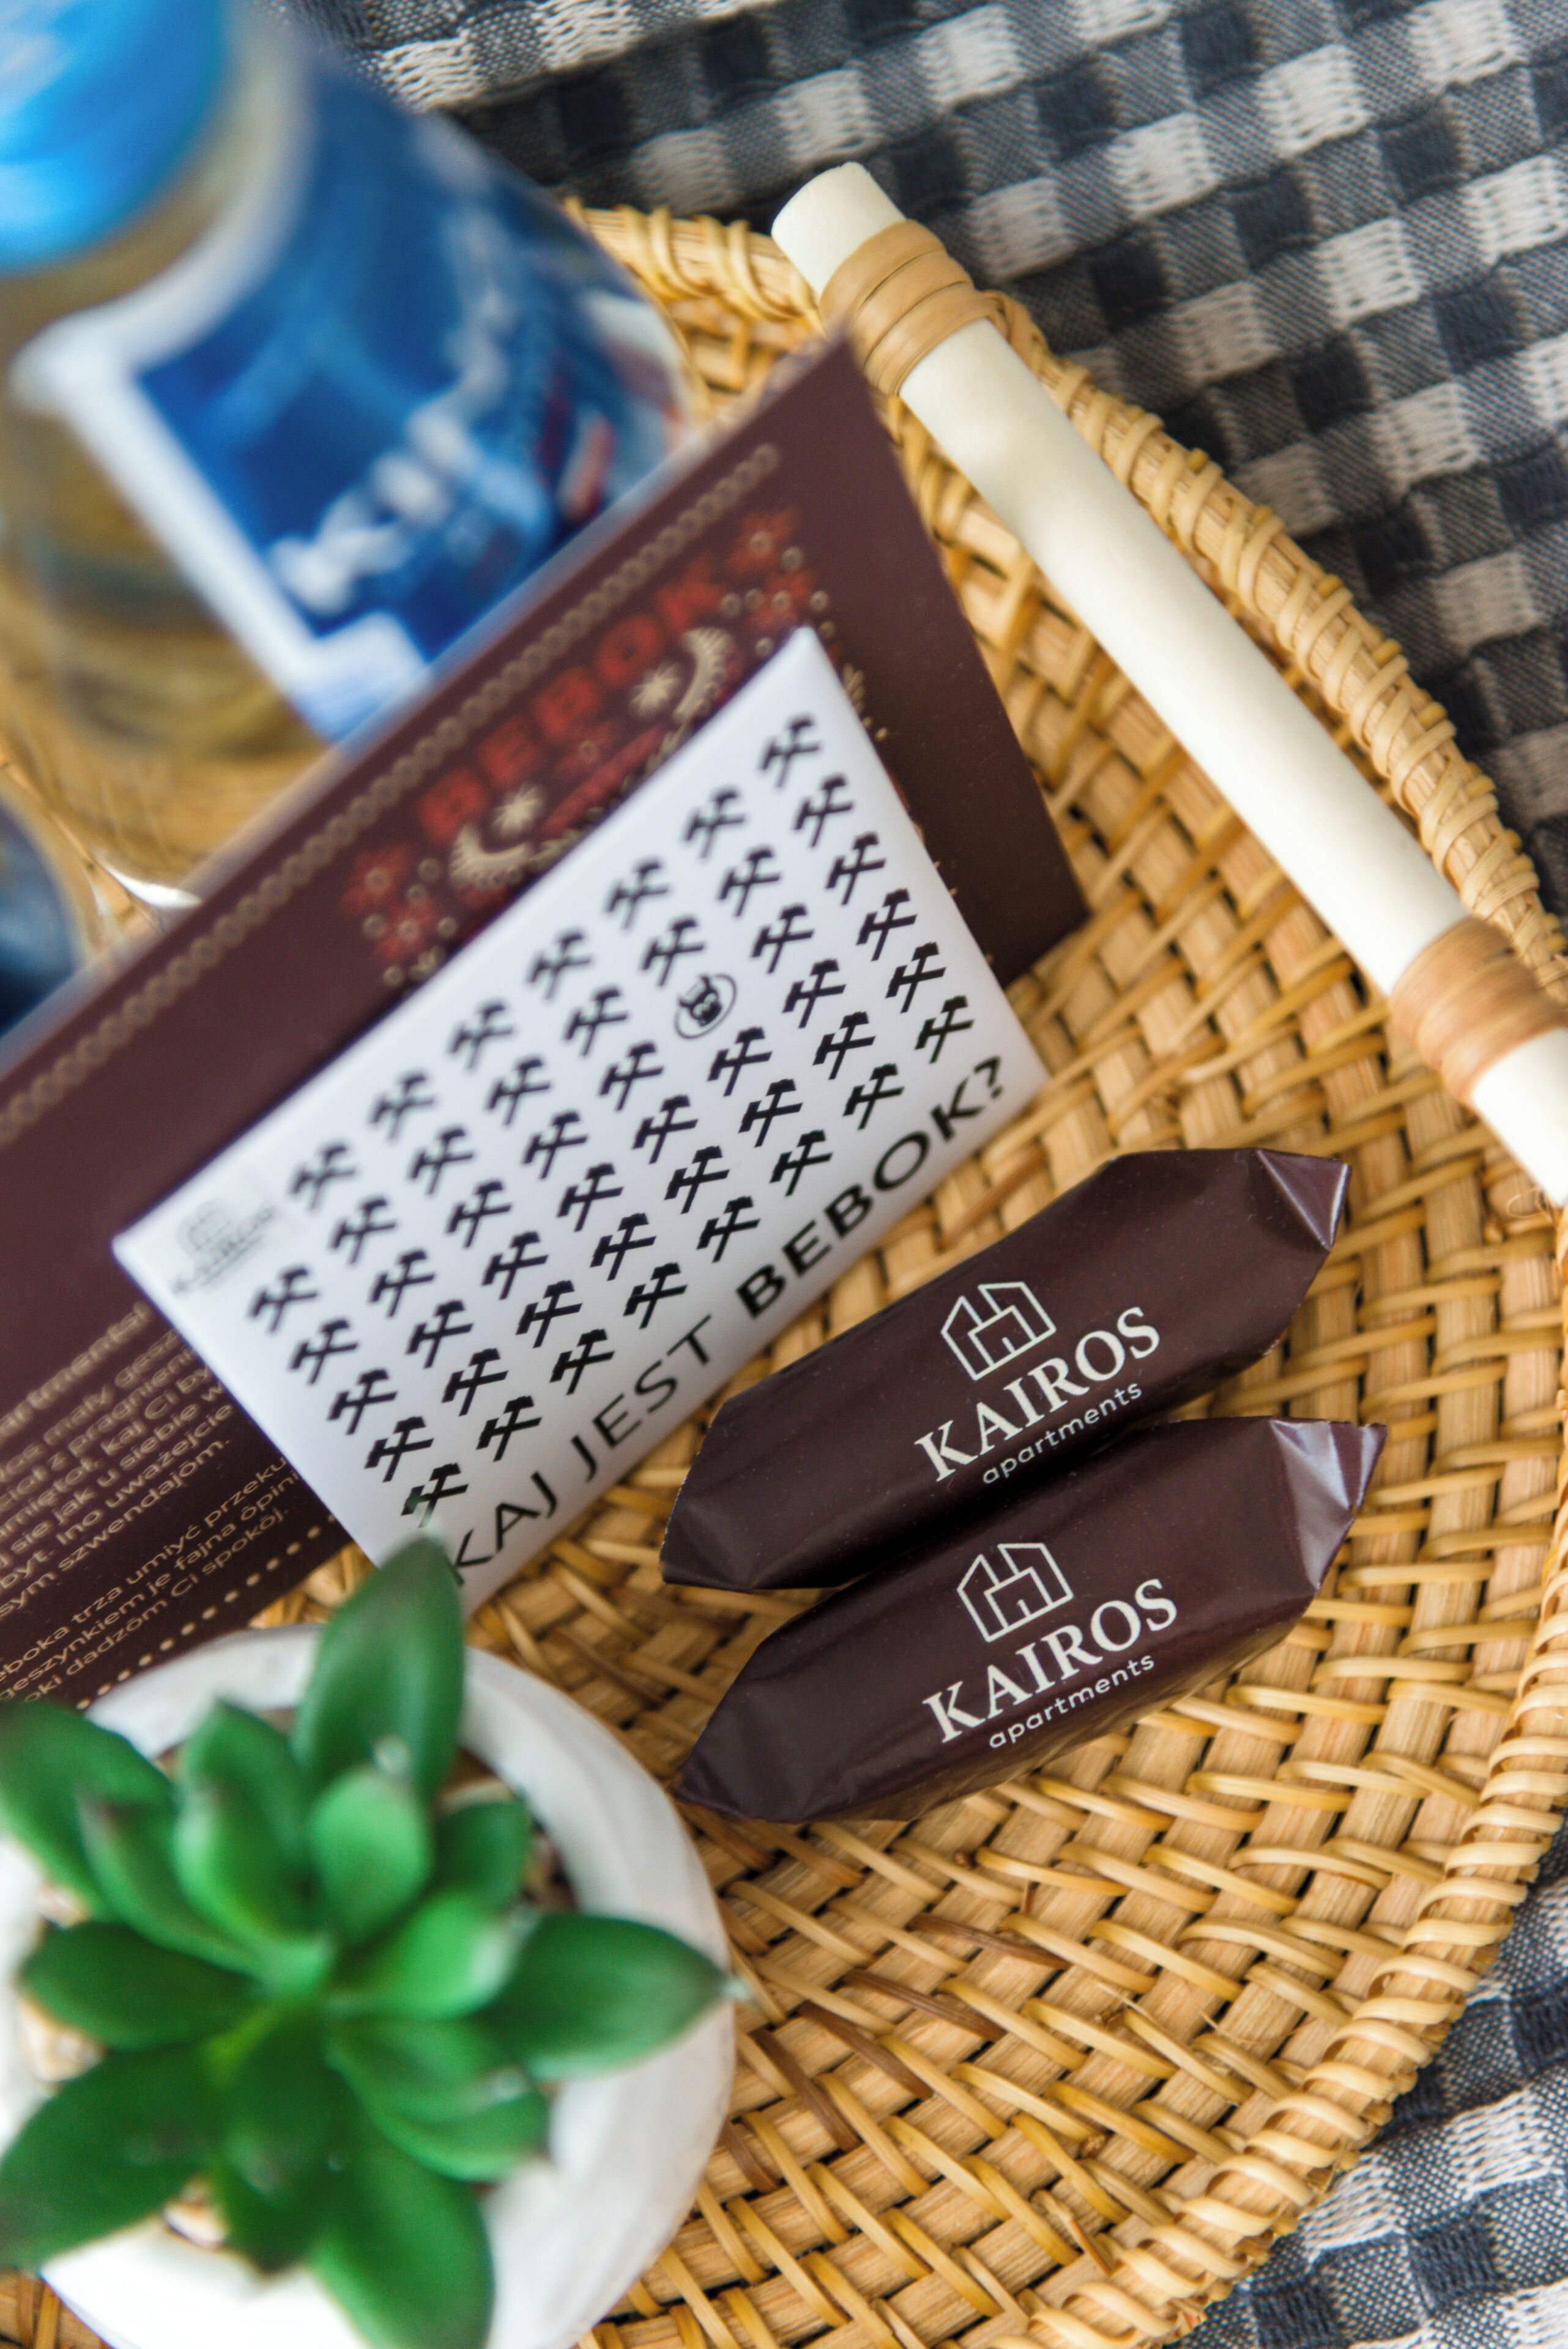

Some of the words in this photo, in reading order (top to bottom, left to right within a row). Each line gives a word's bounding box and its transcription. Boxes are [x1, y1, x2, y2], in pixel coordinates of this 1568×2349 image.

[418, 551, 729, 844] BEBOK
[445, 1471, 559, 1586] KAJ
[571, 1315, 713, 1480] JEST
[734, 1055, 1003, 1319] BEBOK?
[100, 1419, 147, 1456] kaj
[144, 1390, 180, 1420] Ci
[914, 1307, 1161, 1482] KAIROS
[983, 1383, 1143, 1484] apartments
[10, 1520, 54, 1554] sie
[52, 1486, 96, 1526] jak
[97, 1469, 121, 1488] u
[119, 1403, 200, 1470] siebie
[47, 1451, 69, 1471] z
[105, 1405, 232, 1508] uważejcie
[72, 1586, 122, 1623] trza
[126, 1524, 202, 1586] umiyć
[146, 1573, 171, 1597] je
[174, 1523, 236, 1570] fajna
[171, 1573, 199, 1597] Ci
[922, 1578, 1177, 1743] KAIROS
[989, 1655, 1155, 1748] apartments
